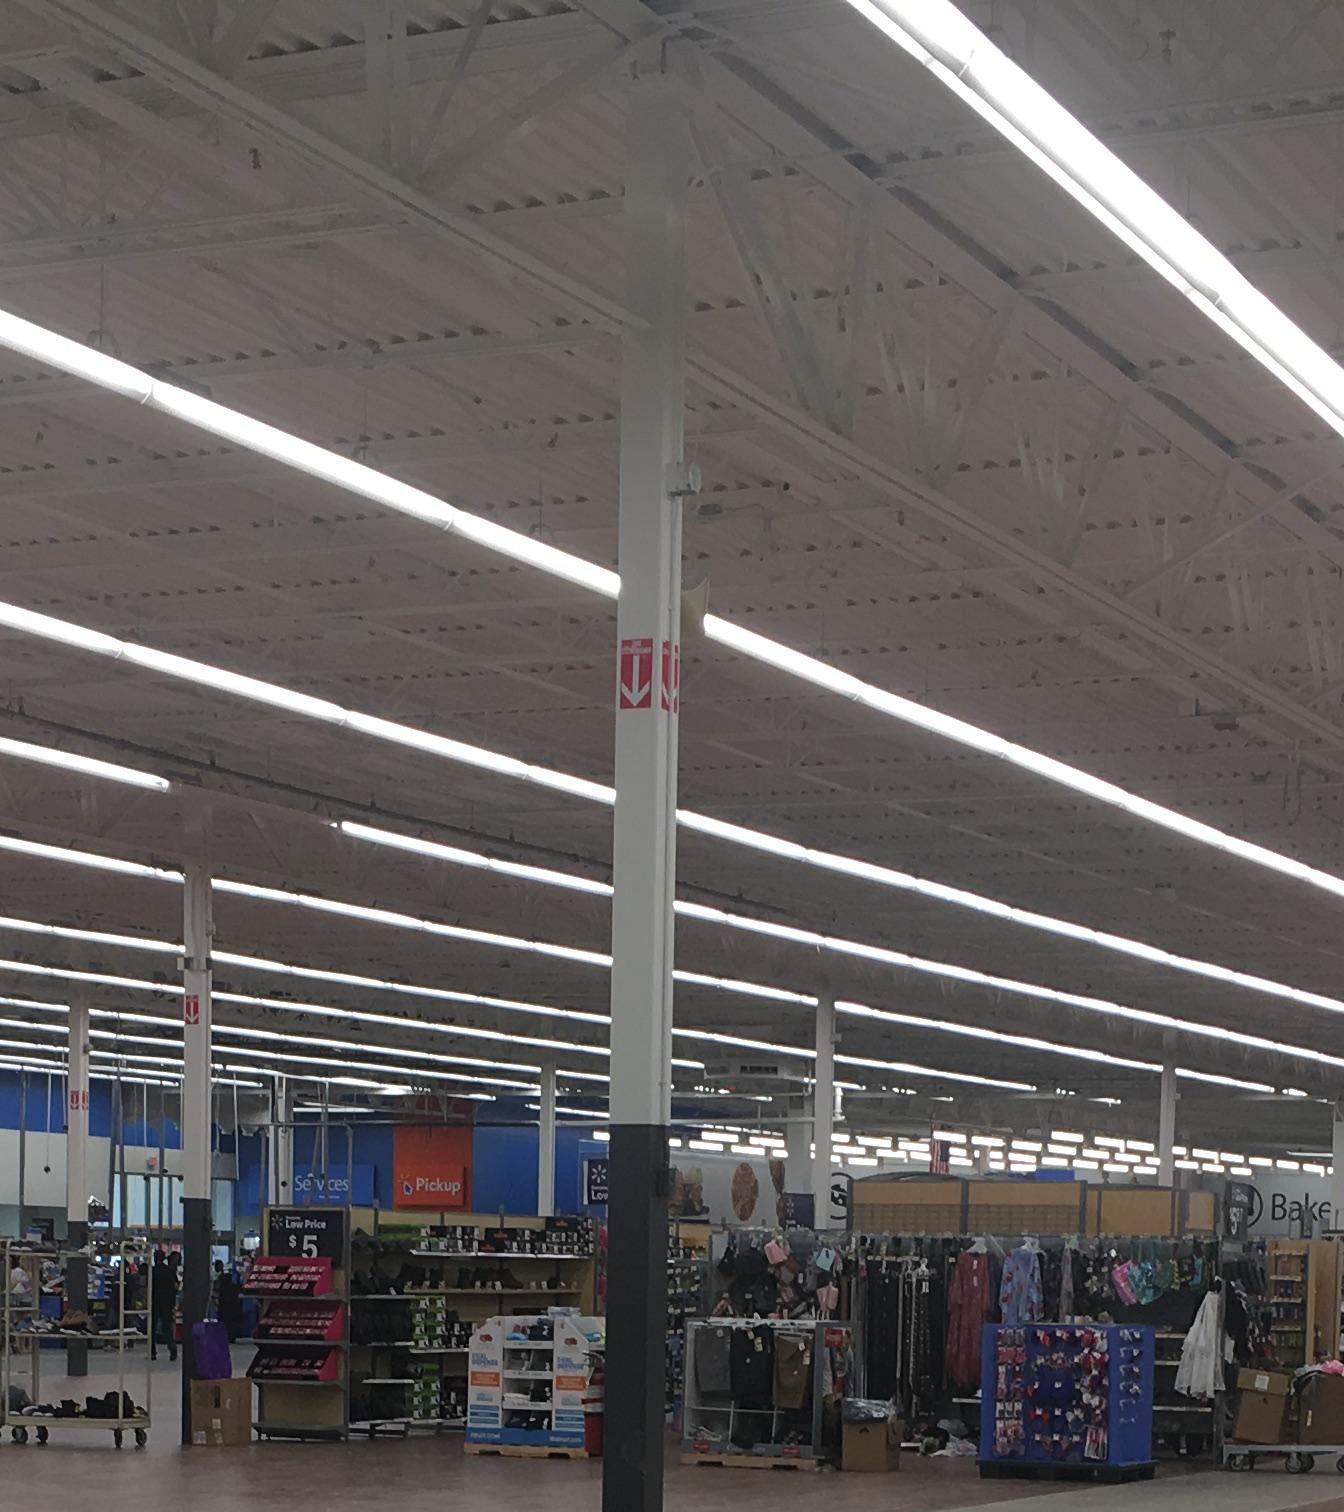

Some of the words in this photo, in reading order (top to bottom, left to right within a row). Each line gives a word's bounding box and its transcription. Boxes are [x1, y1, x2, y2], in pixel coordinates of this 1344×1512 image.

[295, 1175, 349, 1191] Sevces
[416, 1177, 461, 1196] Pickup
[285, 1219, 304, 1229] Low
[305, 1219, 327, 1229] Price
